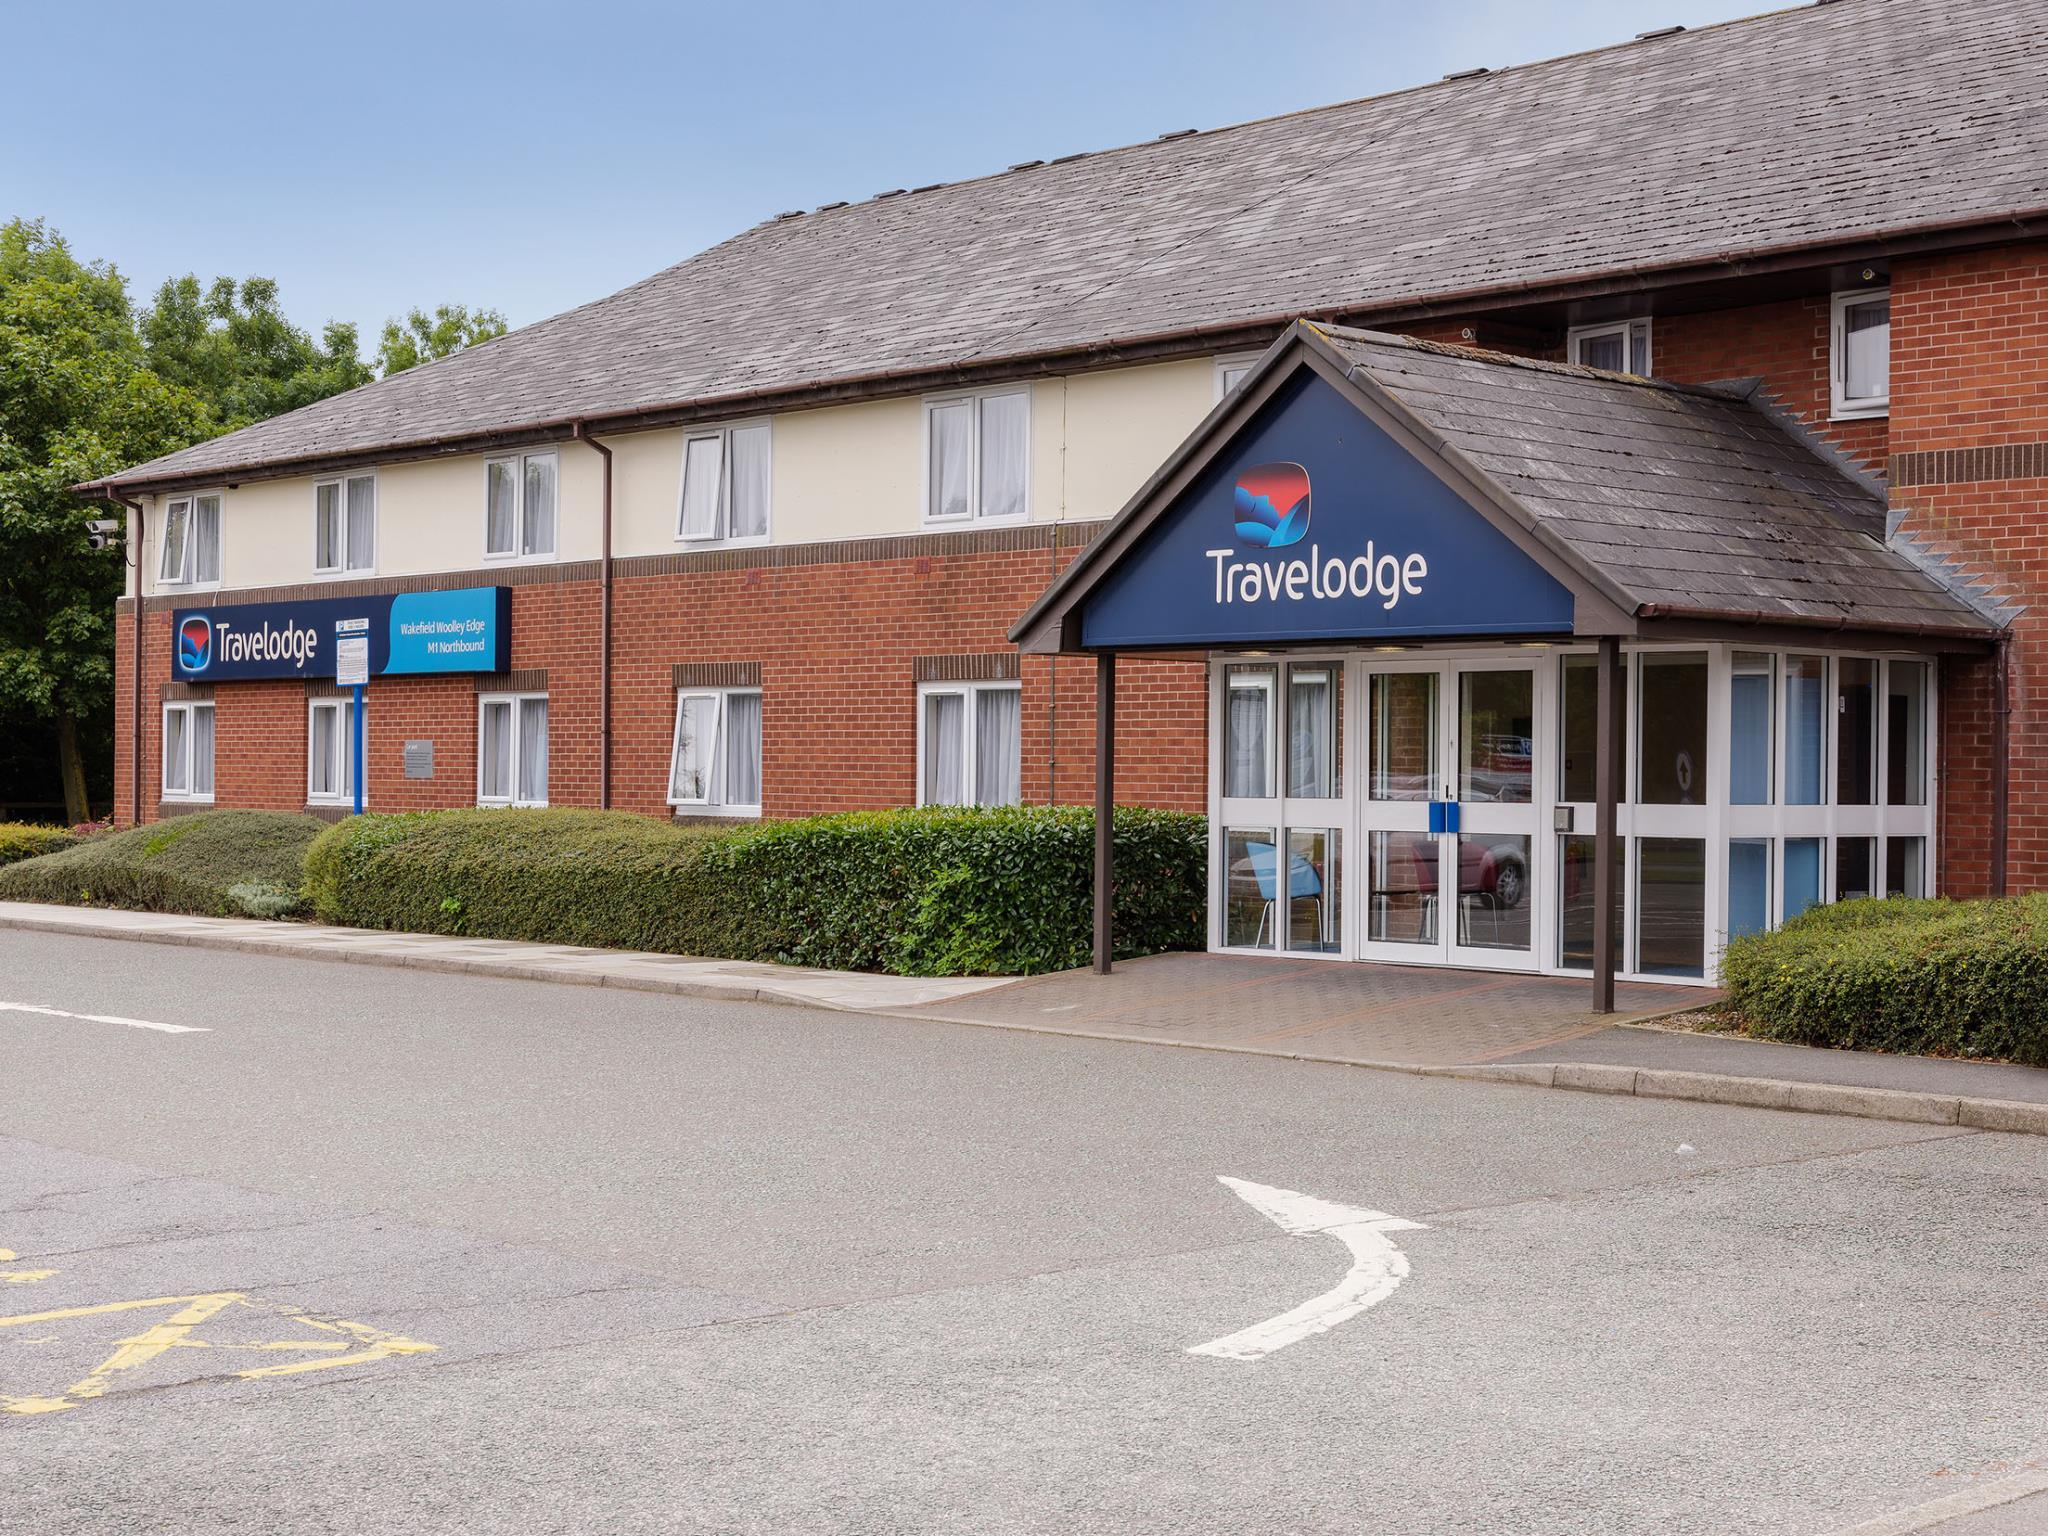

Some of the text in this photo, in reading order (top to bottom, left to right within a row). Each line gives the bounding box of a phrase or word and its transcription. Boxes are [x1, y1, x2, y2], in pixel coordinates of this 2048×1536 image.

[1206, 540, 1428, 610] Travelodge
[401, 619, 485, 635] Wakefield Woolley Edge
[216, 619, 317, 668] Travelodge
[428, 638, 485, 654] M1 Northbound
